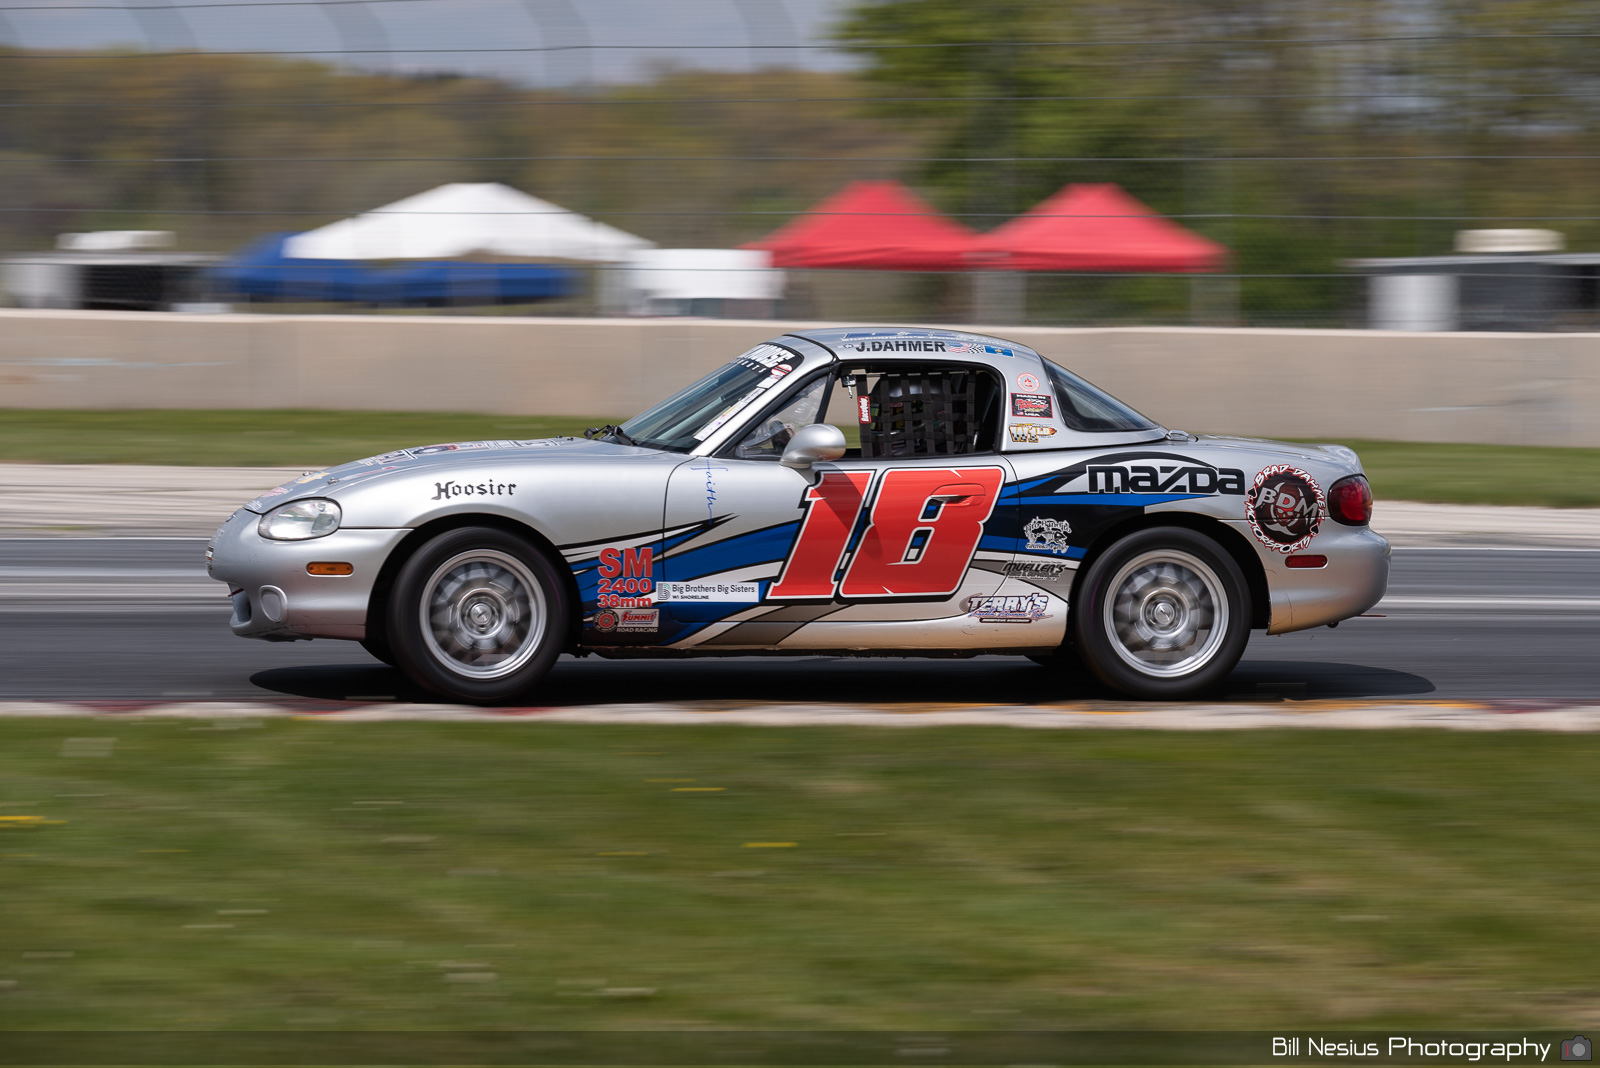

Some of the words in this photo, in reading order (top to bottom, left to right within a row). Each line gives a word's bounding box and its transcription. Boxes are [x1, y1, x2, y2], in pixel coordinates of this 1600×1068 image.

[856, 341, 946, 353] J.DAHMER
[431, 479, 518, 501] Hoosier
[691, 459, 728, 525] faith
[1254, 464, 1290, 486] BRAD
[1293, 468, 1326, 521] DAHMER
[1254, 487, 1318, 525] BDM
[766, 465, 1006, 602] 18
[1244, 501, 1310, 554] MOTORSPORTS
[597, 547, 653, 578] SM
[1002, 563, 1066, 573] MUELLER'S
[597, 578, 652, 594] 2400
[672, 584, 684, 594] Big
[685, 584, 716, 593] Brothers
[717, 584, 729, 595] Big
[597, 594, 652, 609] 38mm
[968, 593, 1049, 613] TERRY'S
